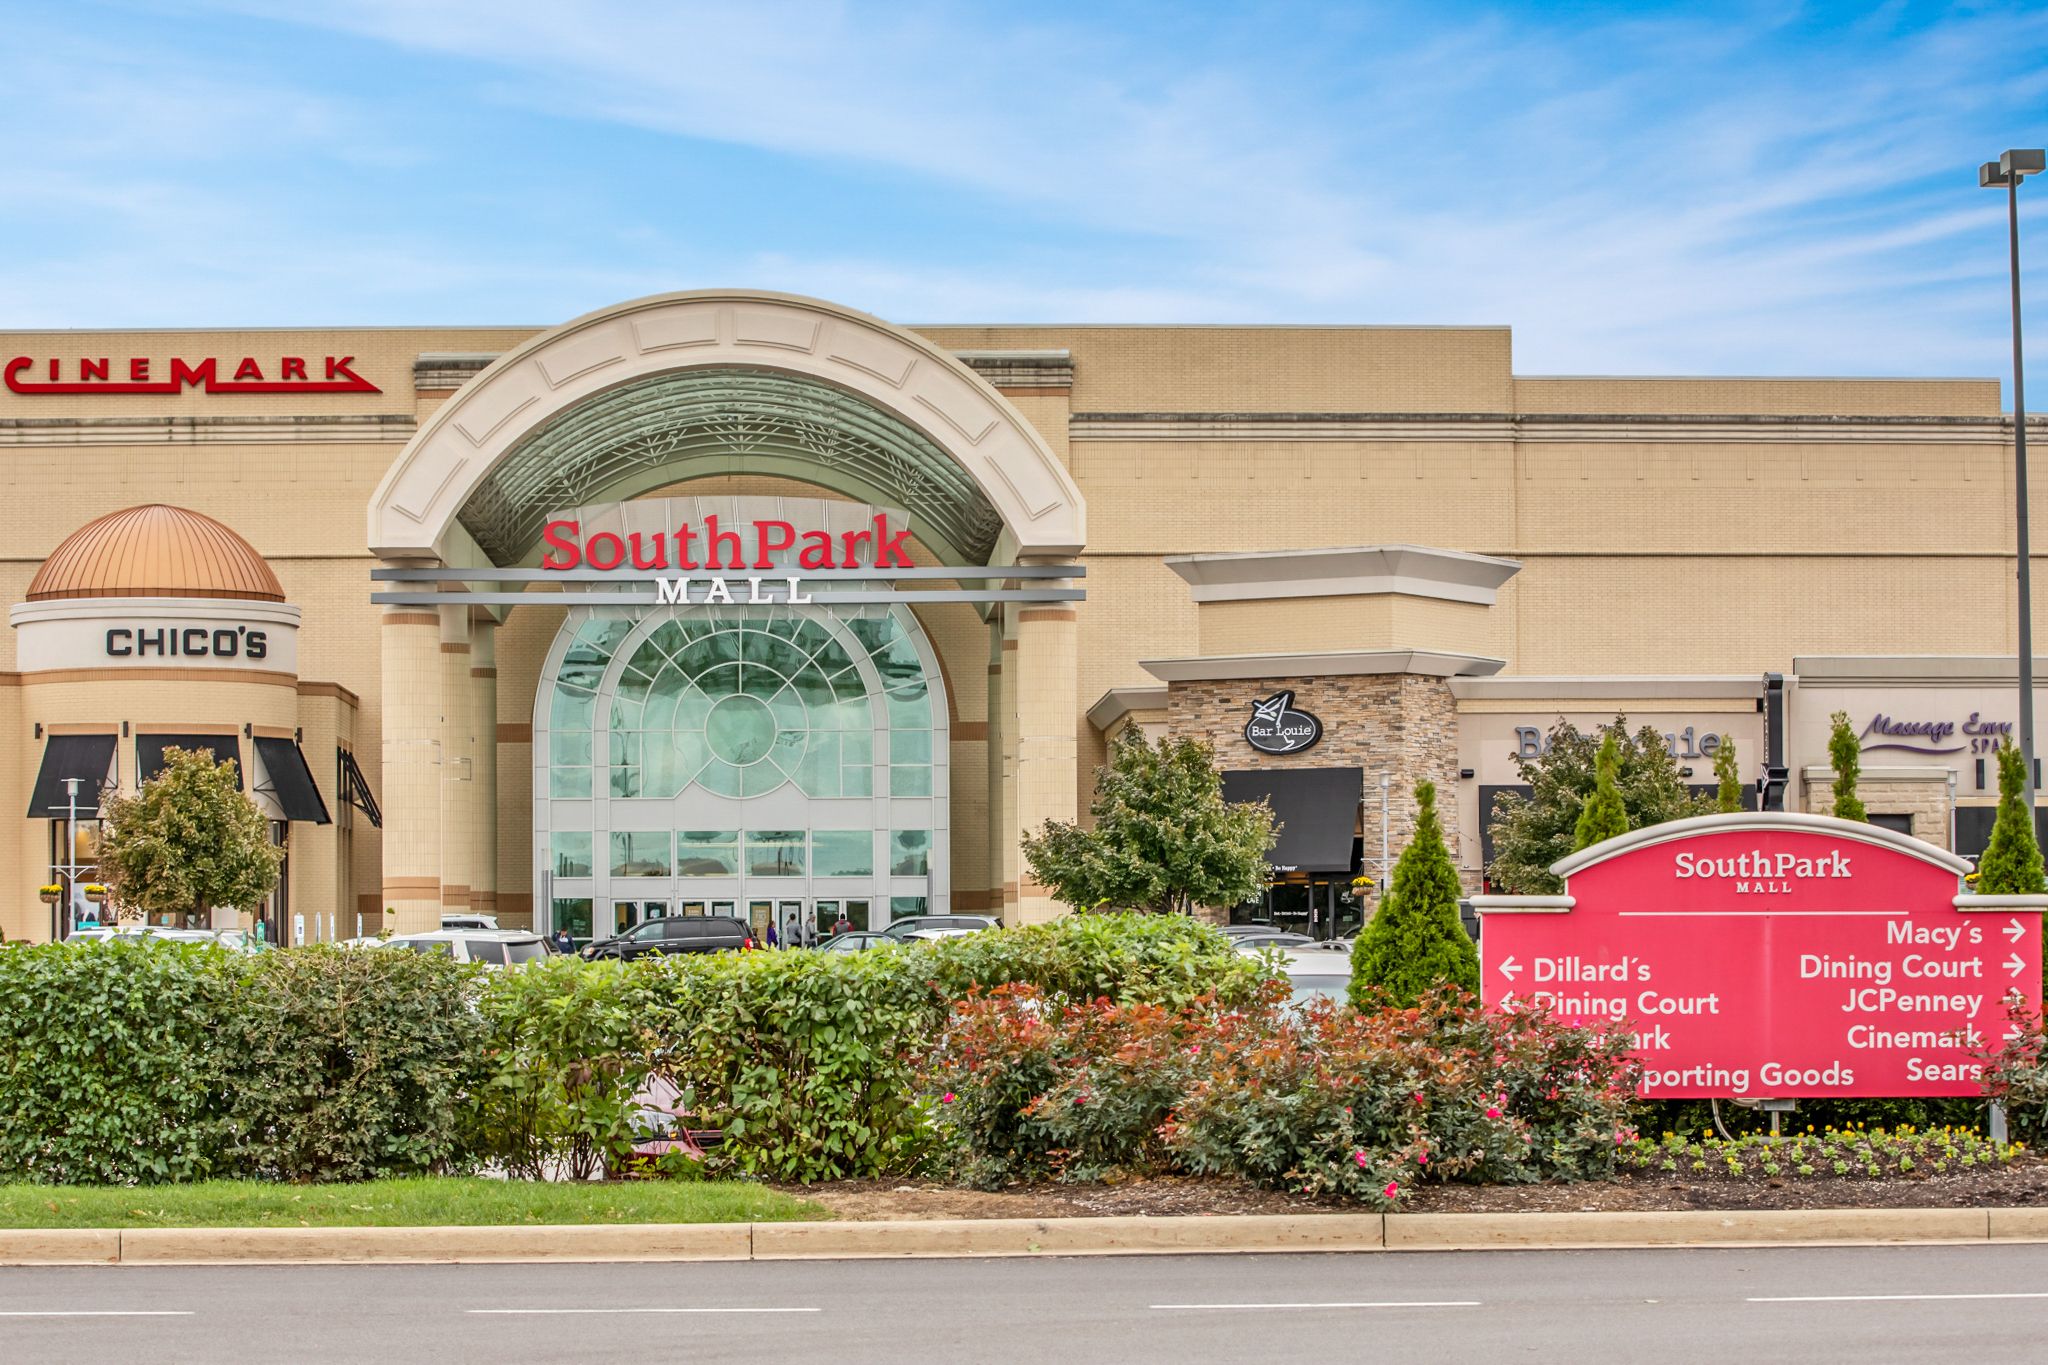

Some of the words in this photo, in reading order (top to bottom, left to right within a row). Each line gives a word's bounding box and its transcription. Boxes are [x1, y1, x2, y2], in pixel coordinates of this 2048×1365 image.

[4, 355, 382, 394] CINEMARK
[543, 513, 915, 571] SouthPark
[655, 576, 814, 605] MALL
[105, 624, 268, 660] CHICO'S
[1251, 726, 1274, 737] Bar
[1275, 724, 1312, 737] Louie
[1859, 713, 1954, 743] Massage
[1971, 738, 2001, 754] SPA
[1676, 850, 1852, 879] SouthPark
[1736, 881, 1793, 894] MALL
[1800, 954, 1892, 985] Dining
[1902, 954, 1983, 979] Court
[1534, 990, 1627, 1022] Dining
[1637, 990, 1720, 1015] Court
[1841, 988, 1983, 1018] JCPenney
[1847, 1023, 1983, 1049] Cinemark
[1638, 1061, 1750, 1094] porting
[1759, 1060, 1855, 1088] Goods
[1906, 1057, 1982, 1081] Sears
